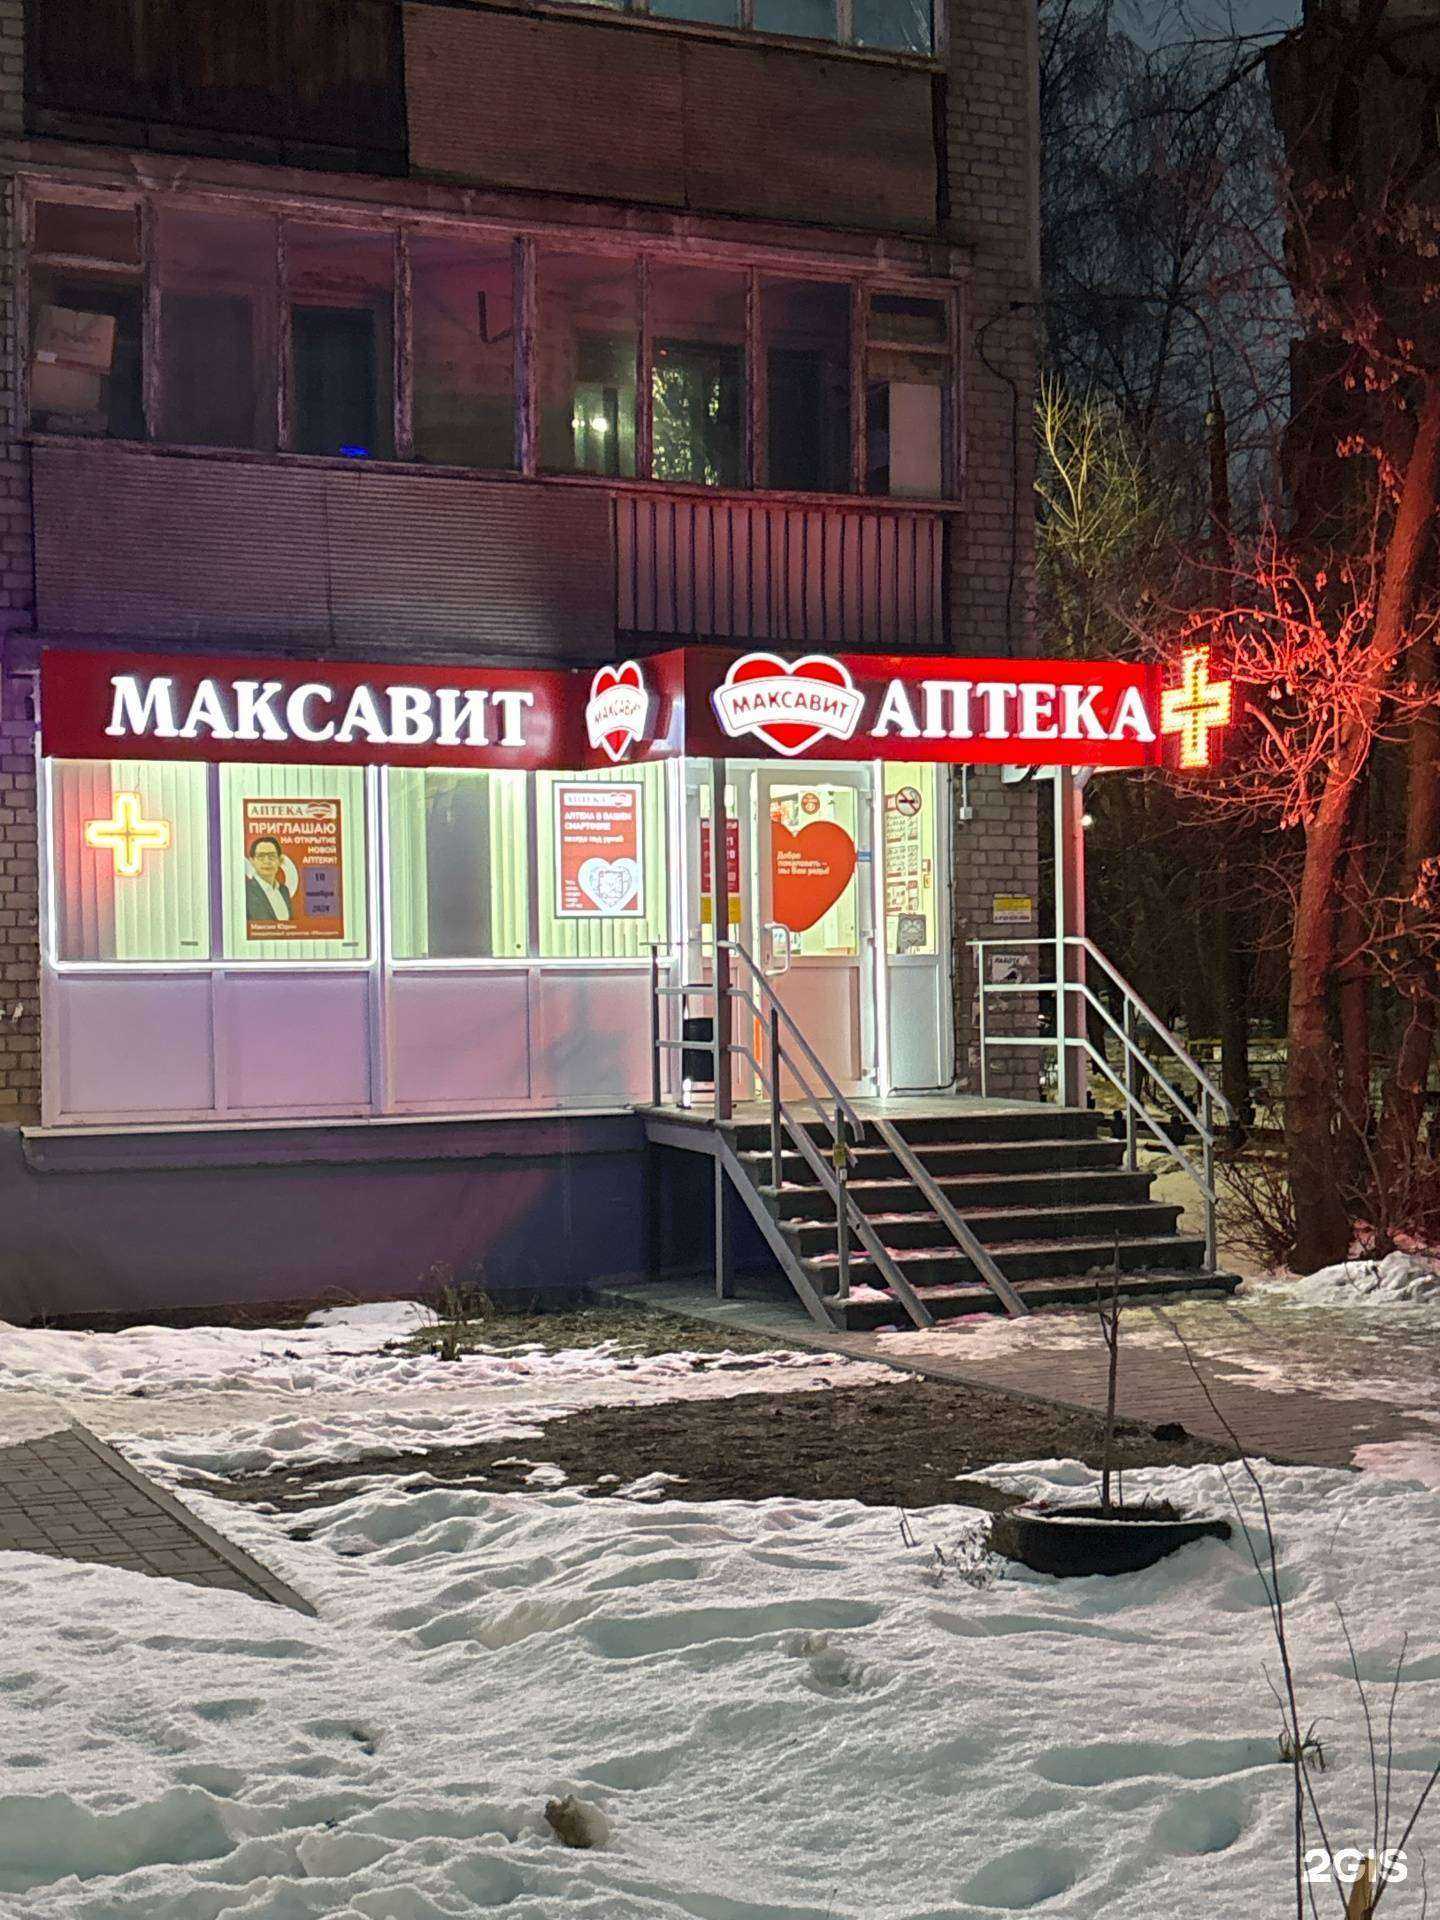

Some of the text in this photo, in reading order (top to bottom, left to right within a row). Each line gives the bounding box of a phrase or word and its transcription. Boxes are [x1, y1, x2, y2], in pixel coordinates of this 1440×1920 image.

[104, 675, 535, 747] МАКСАВИТ
[732, 690, 850, 719] МАКСАВИТ
[870, 678, 1157, 743] АПТЕКА
[250, 805, 304, 816] АПТЕКА
[248, 822, 337, 835] ПРИГЛАШАЮ
